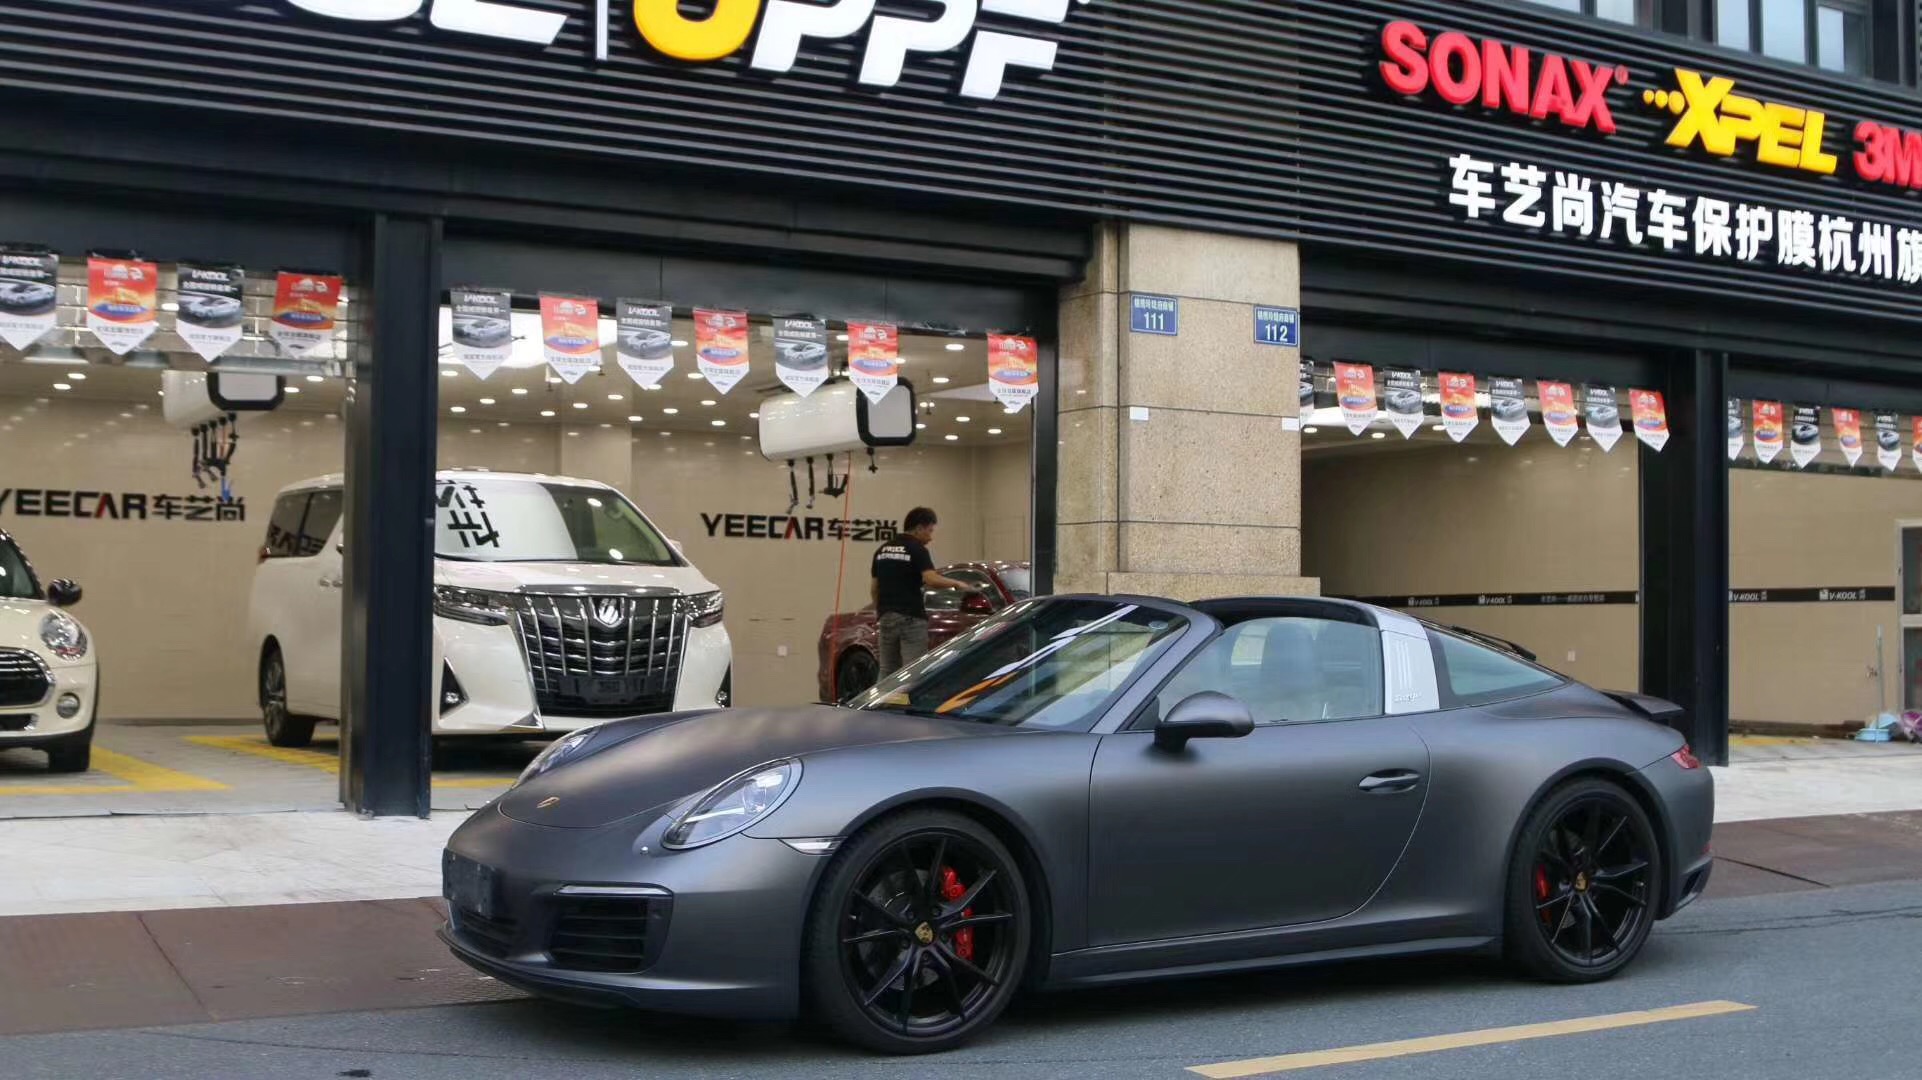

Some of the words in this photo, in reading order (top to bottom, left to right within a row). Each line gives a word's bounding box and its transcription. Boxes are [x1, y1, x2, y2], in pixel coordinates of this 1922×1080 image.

[1664, 67, 1838, 175] XPEL
[1144, 311, 1164, 330] 111
[1265, 323, 1288, 341] 112
[152, 494, 246, 522] 车艺尚
[701, 513, 824, 541] YEECAR
[827, 518, 898, 542] 车艺尚
